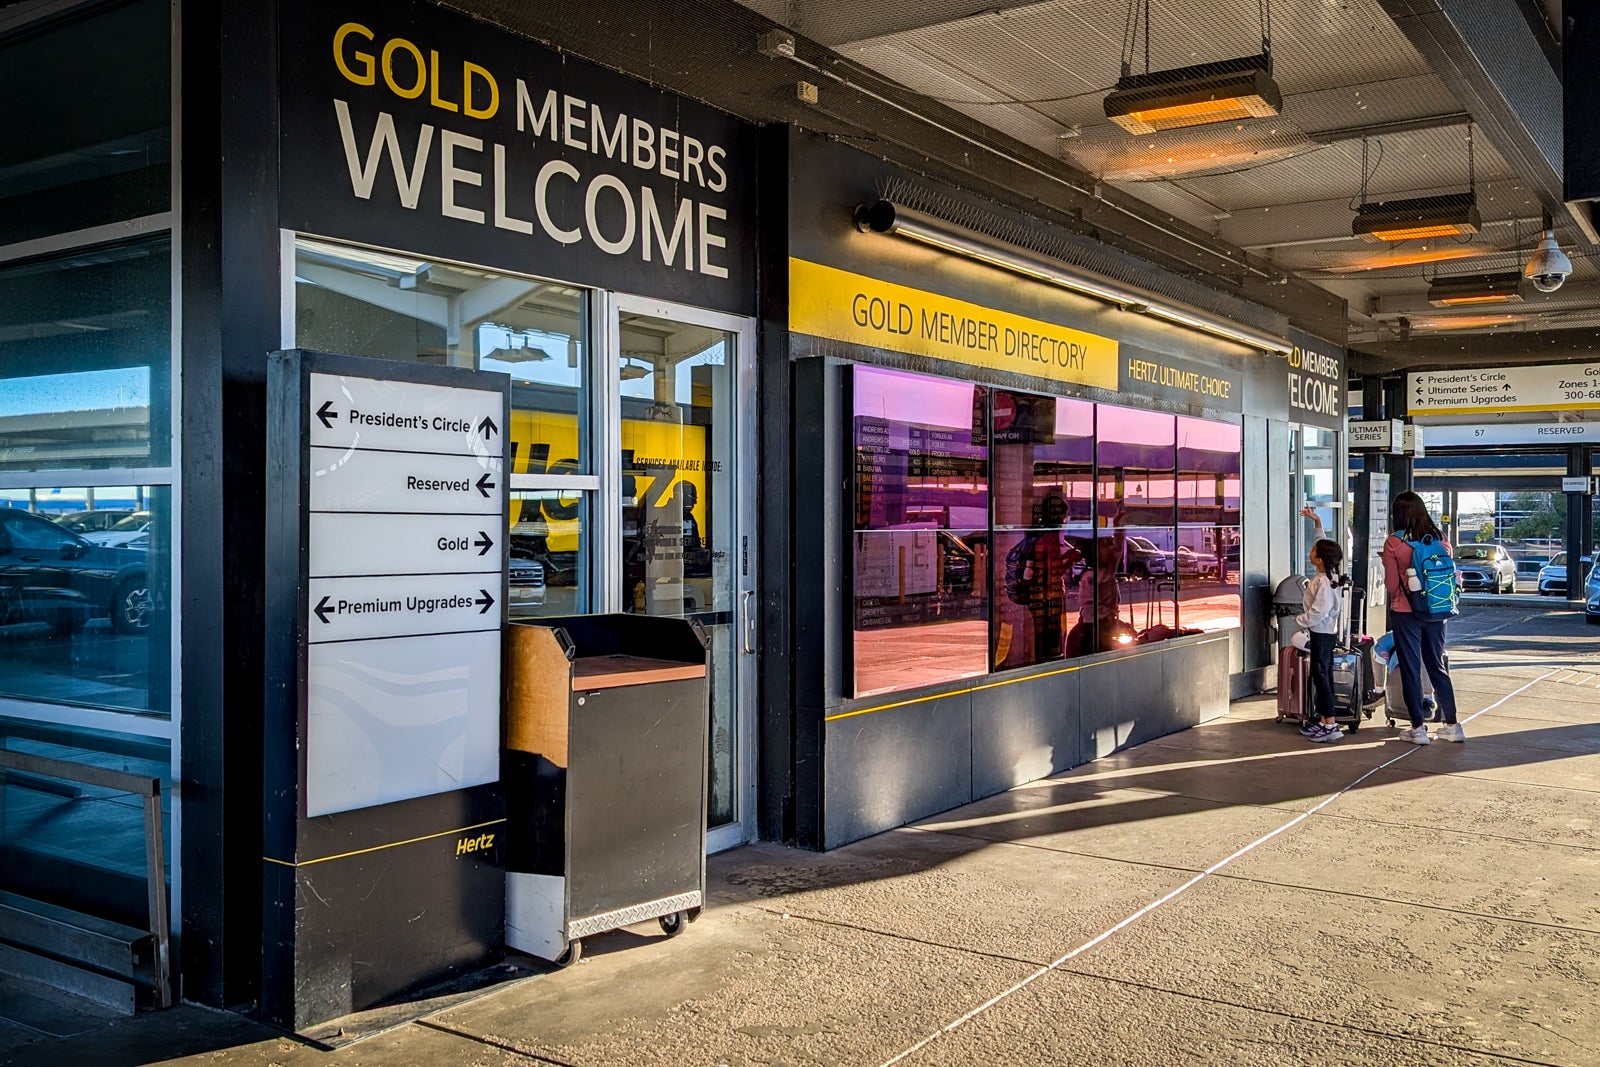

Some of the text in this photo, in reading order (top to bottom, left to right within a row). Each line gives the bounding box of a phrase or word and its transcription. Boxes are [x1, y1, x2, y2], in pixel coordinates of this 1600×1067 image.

[332, 22, 727, 193] GOLD MEMBERS
[334, 98, 728, 279] WELCOME
[852, 293, 1087, 370] GOLD MEMBER DIRECTORY
[1288, 346, 1338, 380] LD MEMBERS
[1128, 358, 1158, 384] HERTZ
[1160, 364, 1198, 392] ULTIMATE
[1428, 372, 1506, 384] President's Circle
[1558, 380, 1588, 388] Zones
[1288, 372, 1338, 416] ELCOME
[1470, 384, 1498, 392] Series
[1428, 395, 1517, 405] Premium Upgrades
[350, 410, 470, 432] President's Circle
[1538, 427, 1584, 435] RESERVED
[407, 476, 470, 491] Reserved
[437, 537, 468, 550] Gold
[338, 595, 472, 614] Premium Upgrades
[456, 834, 495, 856] Hertz
